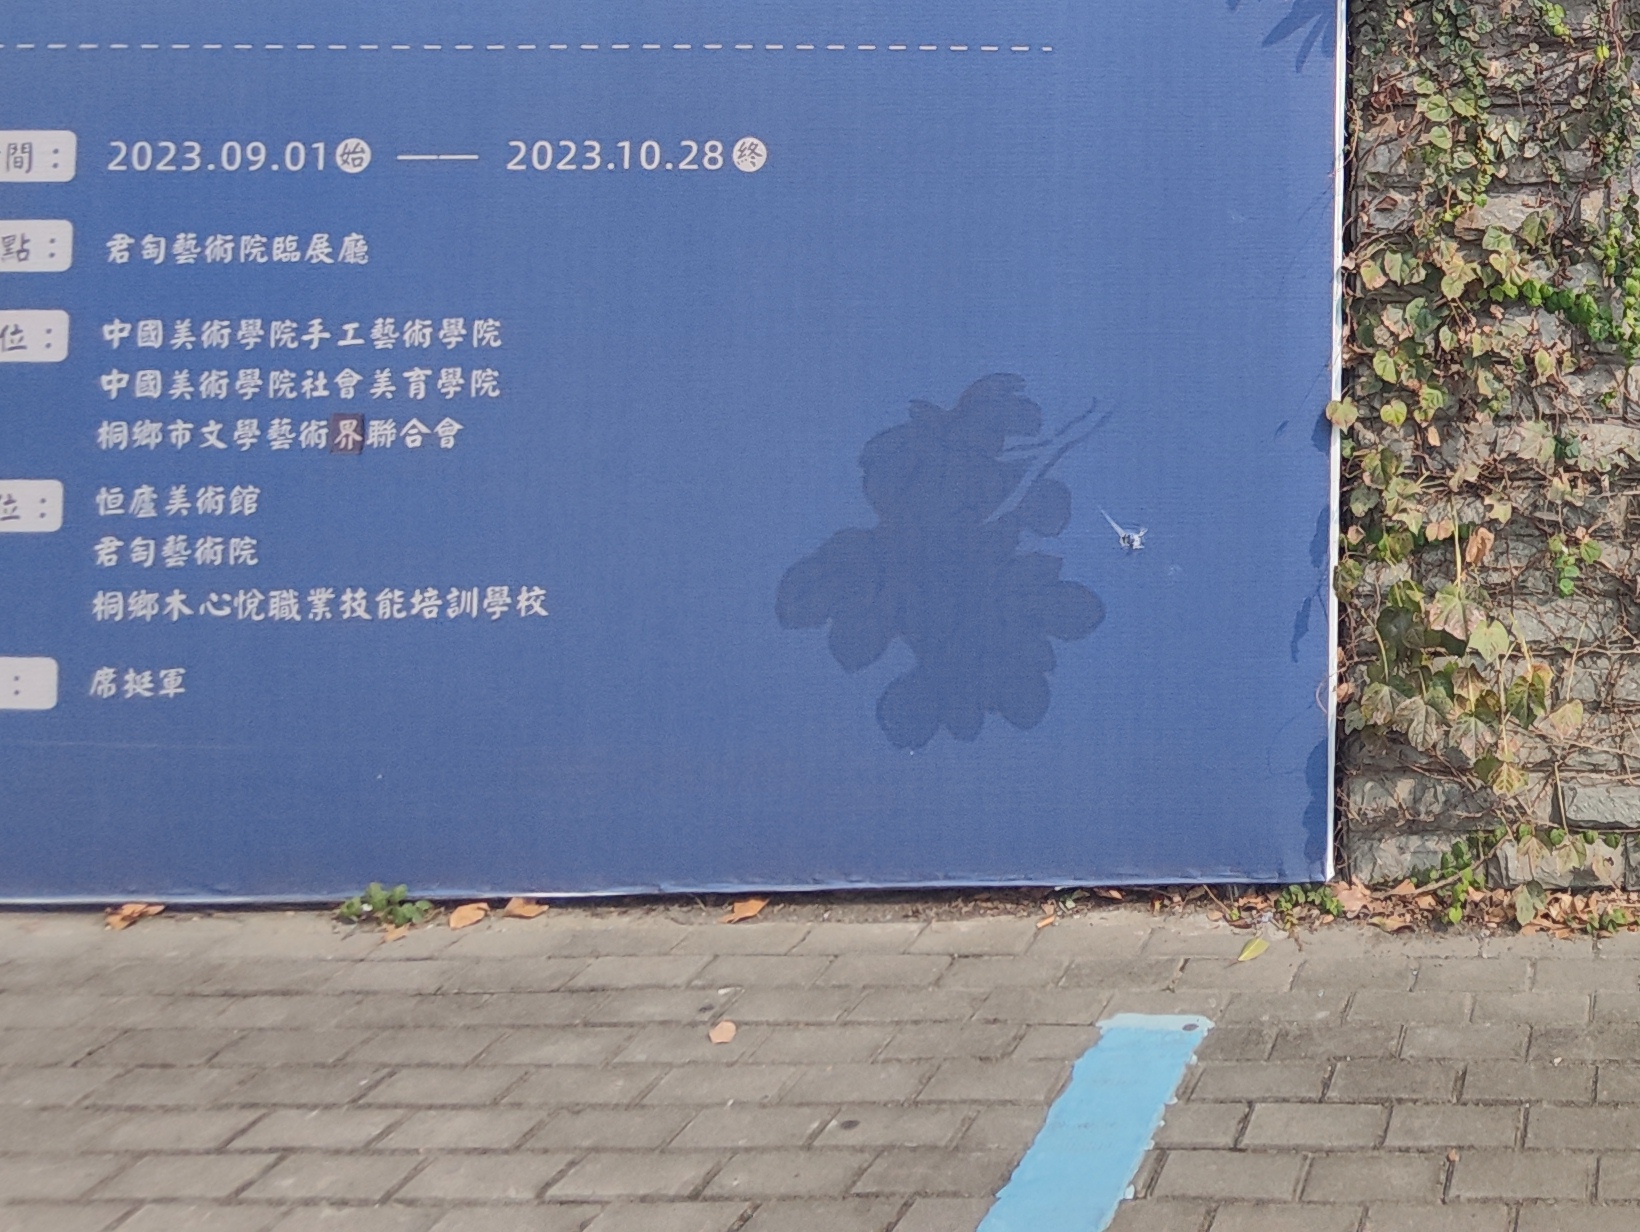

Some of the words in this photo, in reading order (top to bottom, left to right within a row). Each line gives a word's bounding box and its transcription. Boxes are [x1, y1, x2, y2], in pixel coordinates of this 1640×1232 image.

[102, 317, 502, 351] 中國美術學院手工藝術學院
[100, 366, 501, 400] 中國美術學院社會美育學院
[94, 534, 259, 568] 君匋藝術院
[90, 666, 187, 699] 席挺軍
